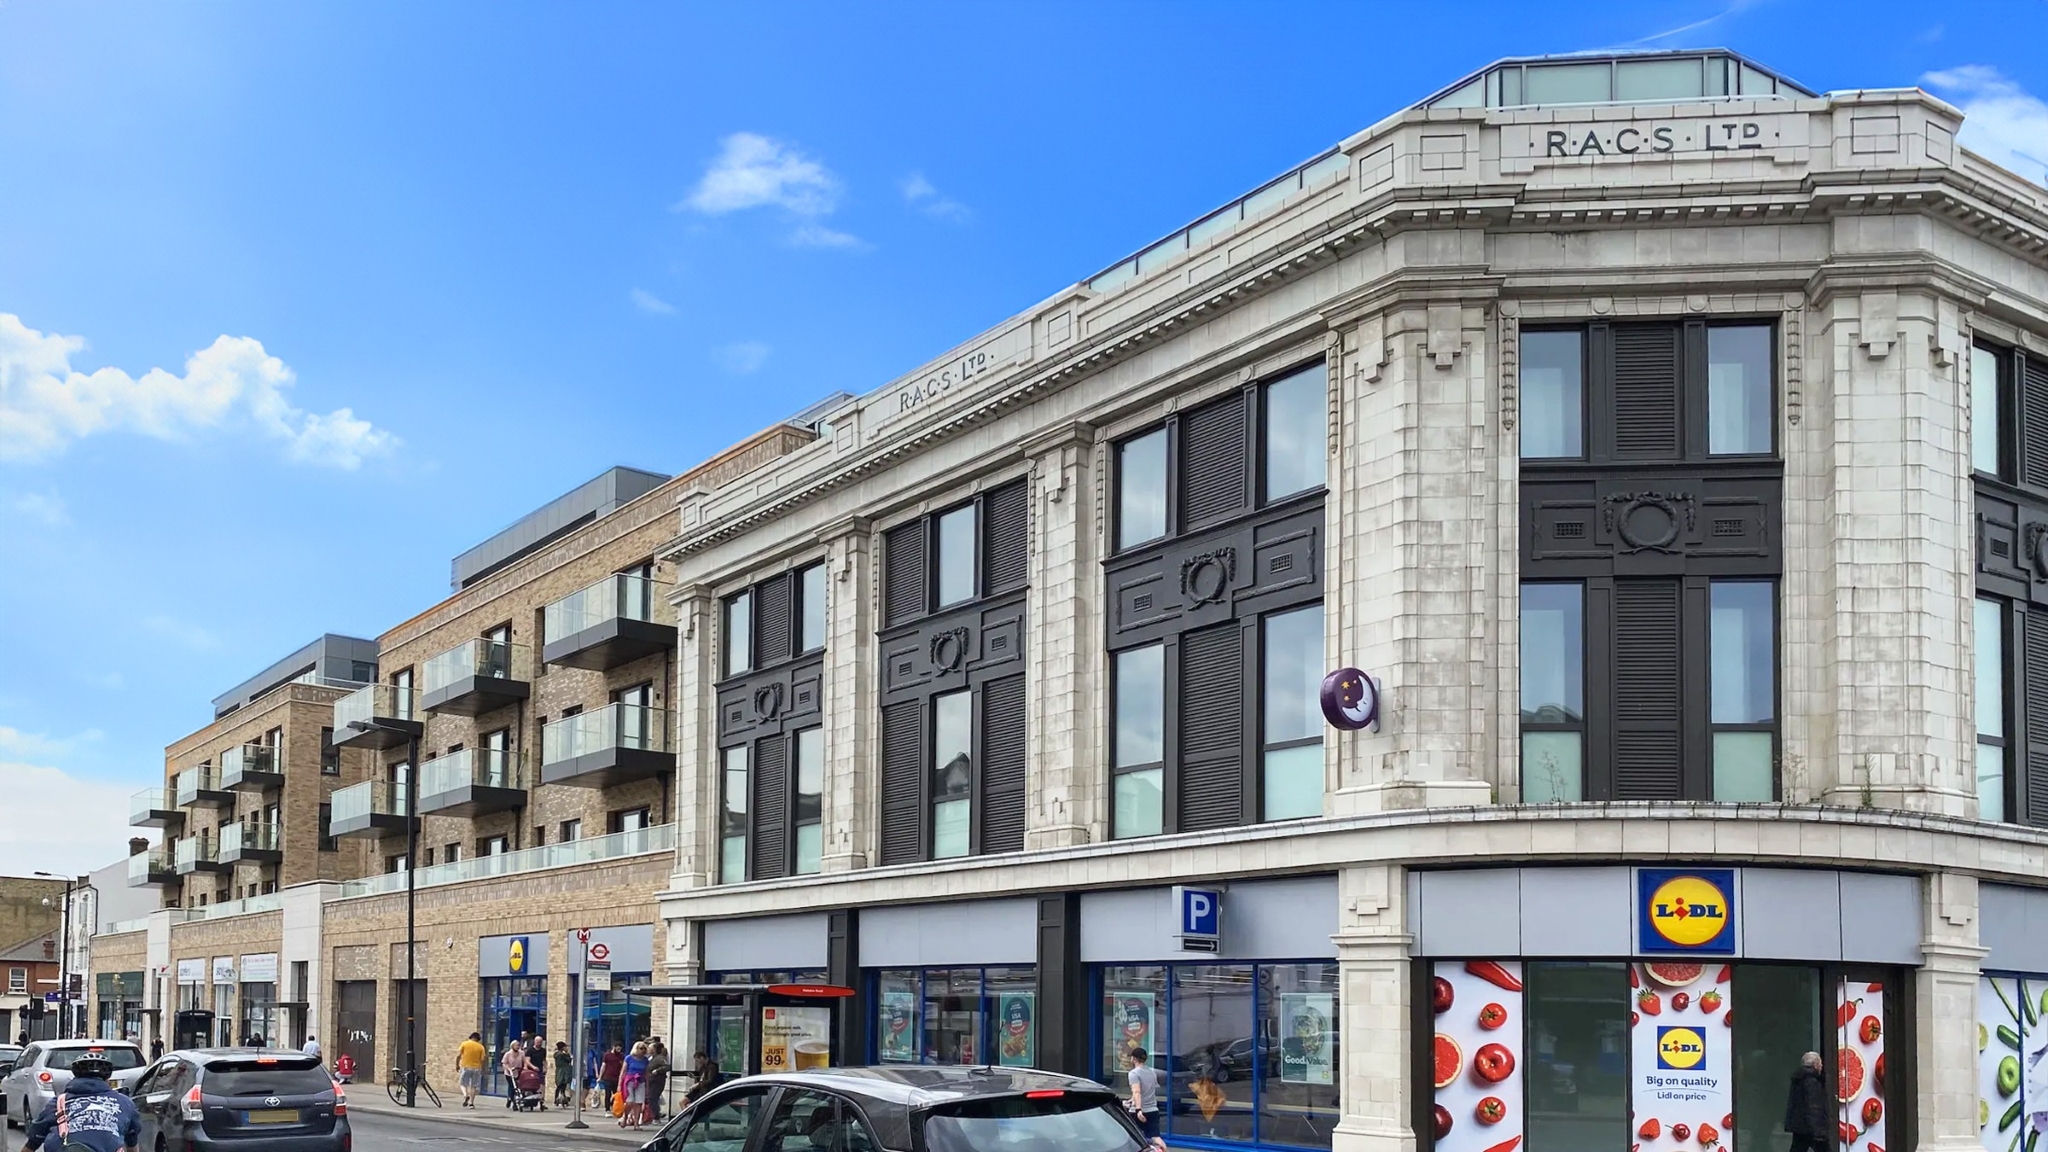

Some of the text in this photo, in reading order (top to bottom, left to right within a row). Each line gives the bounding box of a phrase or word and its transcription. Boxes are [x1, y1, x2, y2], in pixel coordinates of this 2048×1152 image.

[1190, 893, 1210, 930] P
[579, 929, 589, 939] M
[1011, 1012, 1021, 1020] USA
[1646, 1076, 1663, 1087] Big
[1681, 1077, 1718, 1088] quality
[1685, 1092, 1706, 1101] price
